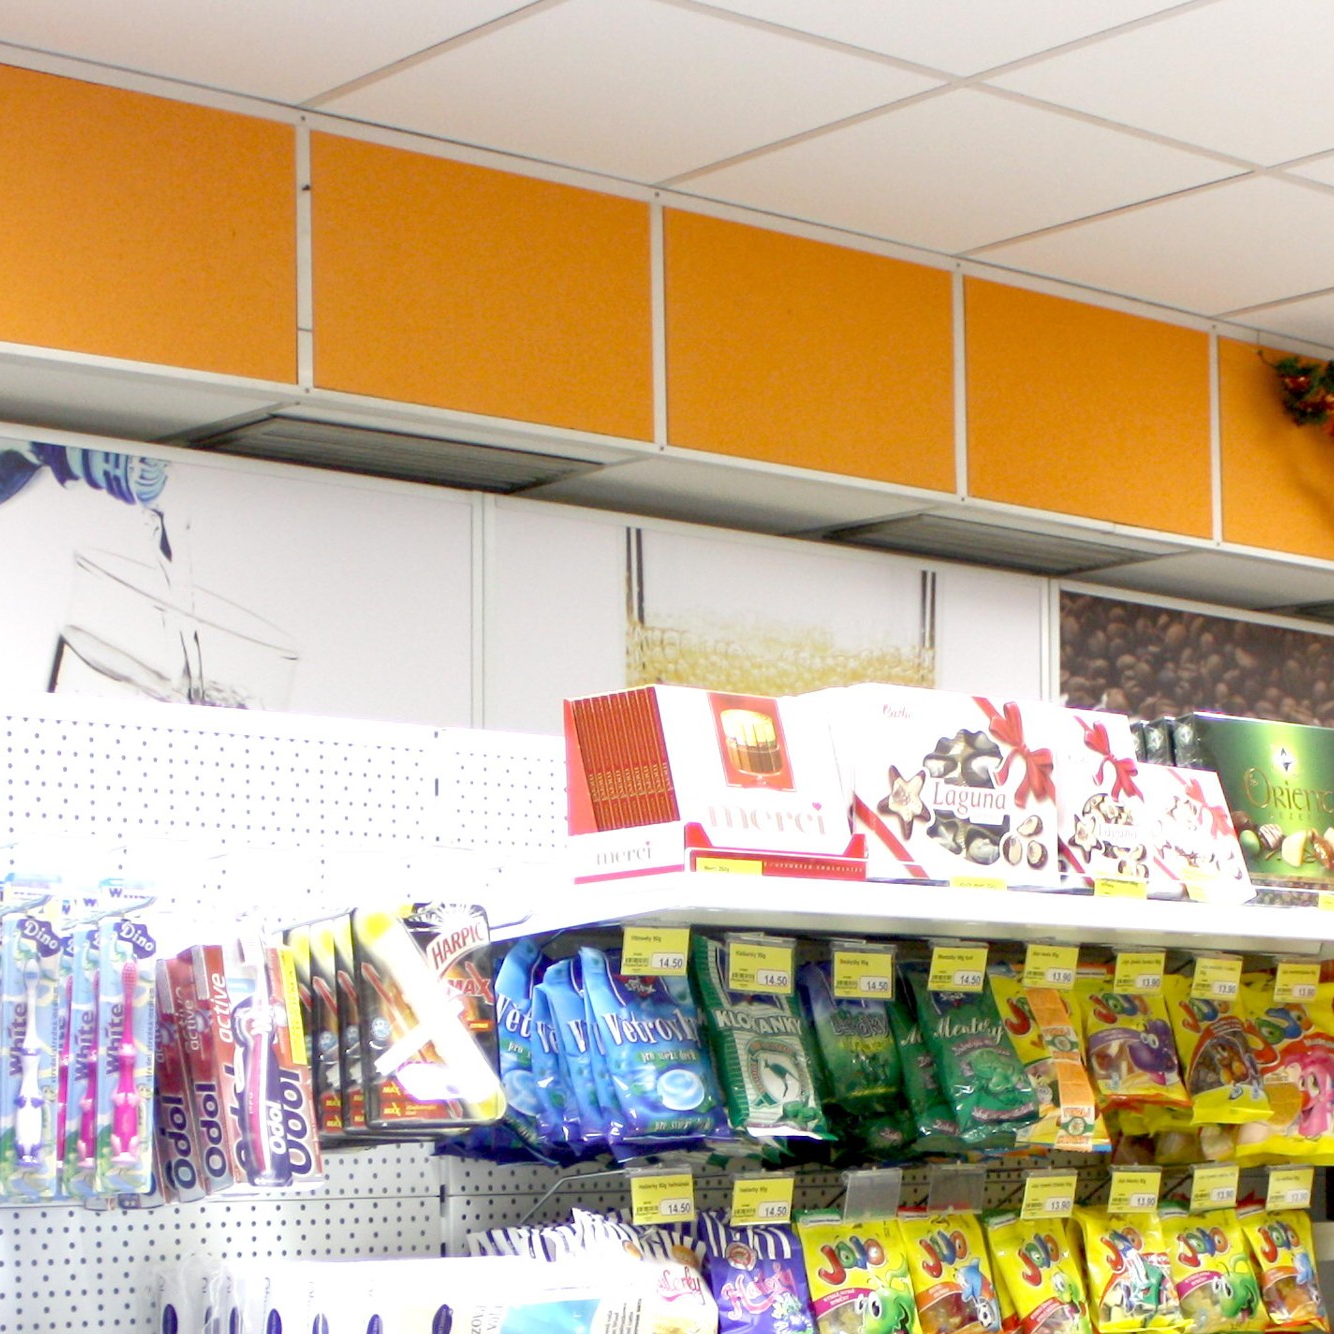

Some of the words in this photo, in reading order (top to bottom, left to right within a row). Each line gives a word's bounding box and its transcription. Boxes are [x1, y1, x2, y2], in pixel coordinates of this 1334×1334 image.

[932, 780, 1007, 812] Laguna
[706, 800, 827, 837] merci
[596, 840, 652, 866] merci
[23, 920, 60, 952] Dino
[119, 921, 155, 954] Dino
[430, 923, 485, 974] HARPIC
[658, 957, 683, 969] 14.50
[763, 974, 788, 986] 14.50
[866, 980, 889, 992] 14.50
[216, 971, 229, 1044] active
[8, 1002, 28, 1077] White
[106, 1003, 124, 1076] White
[204, 1082, 229, 1179] Odol
[668, 1202, 691, 1214] 14.50
[765, 1206, 787, 1218] 14.50
